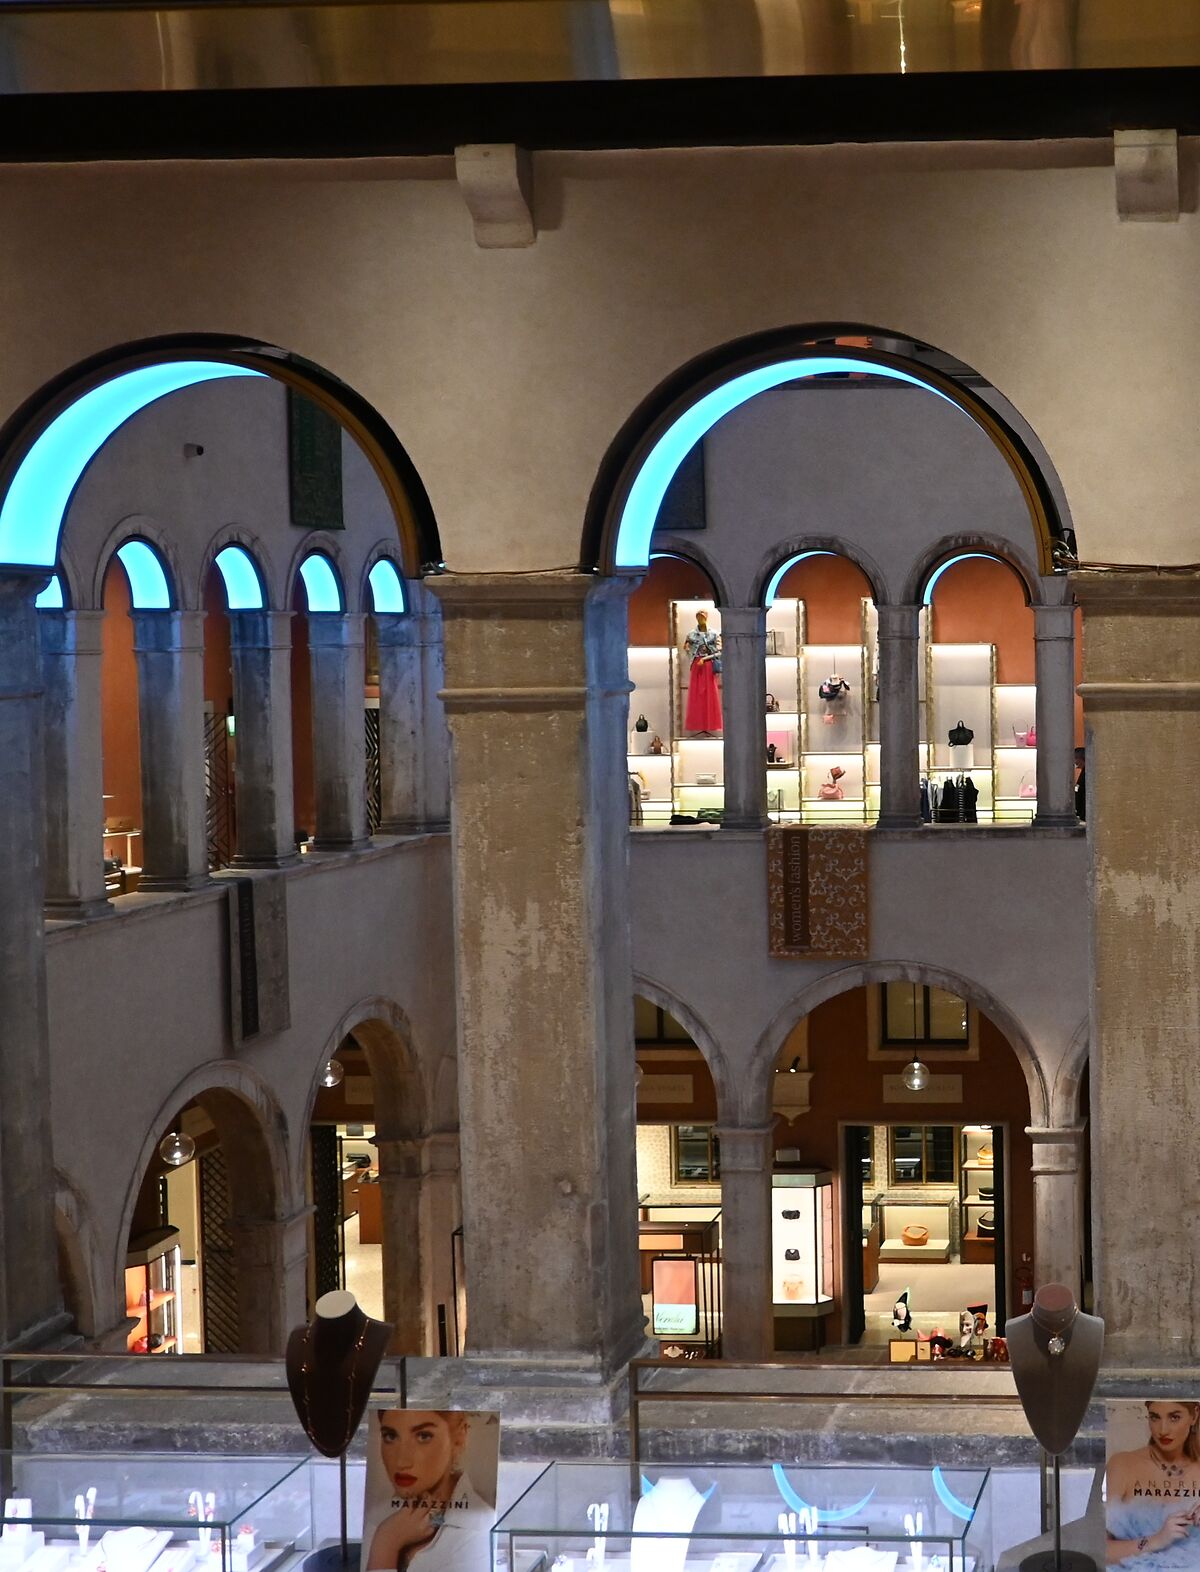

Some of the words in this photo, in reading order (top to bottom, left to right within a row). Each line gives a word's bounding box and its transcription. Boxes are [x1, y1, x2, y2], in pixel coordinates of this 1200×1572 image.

[787, 836, 801, 883] fashion
[787, 888, 801, 943] women's
[391, 1500, 469, 1509] MARAZZINI
